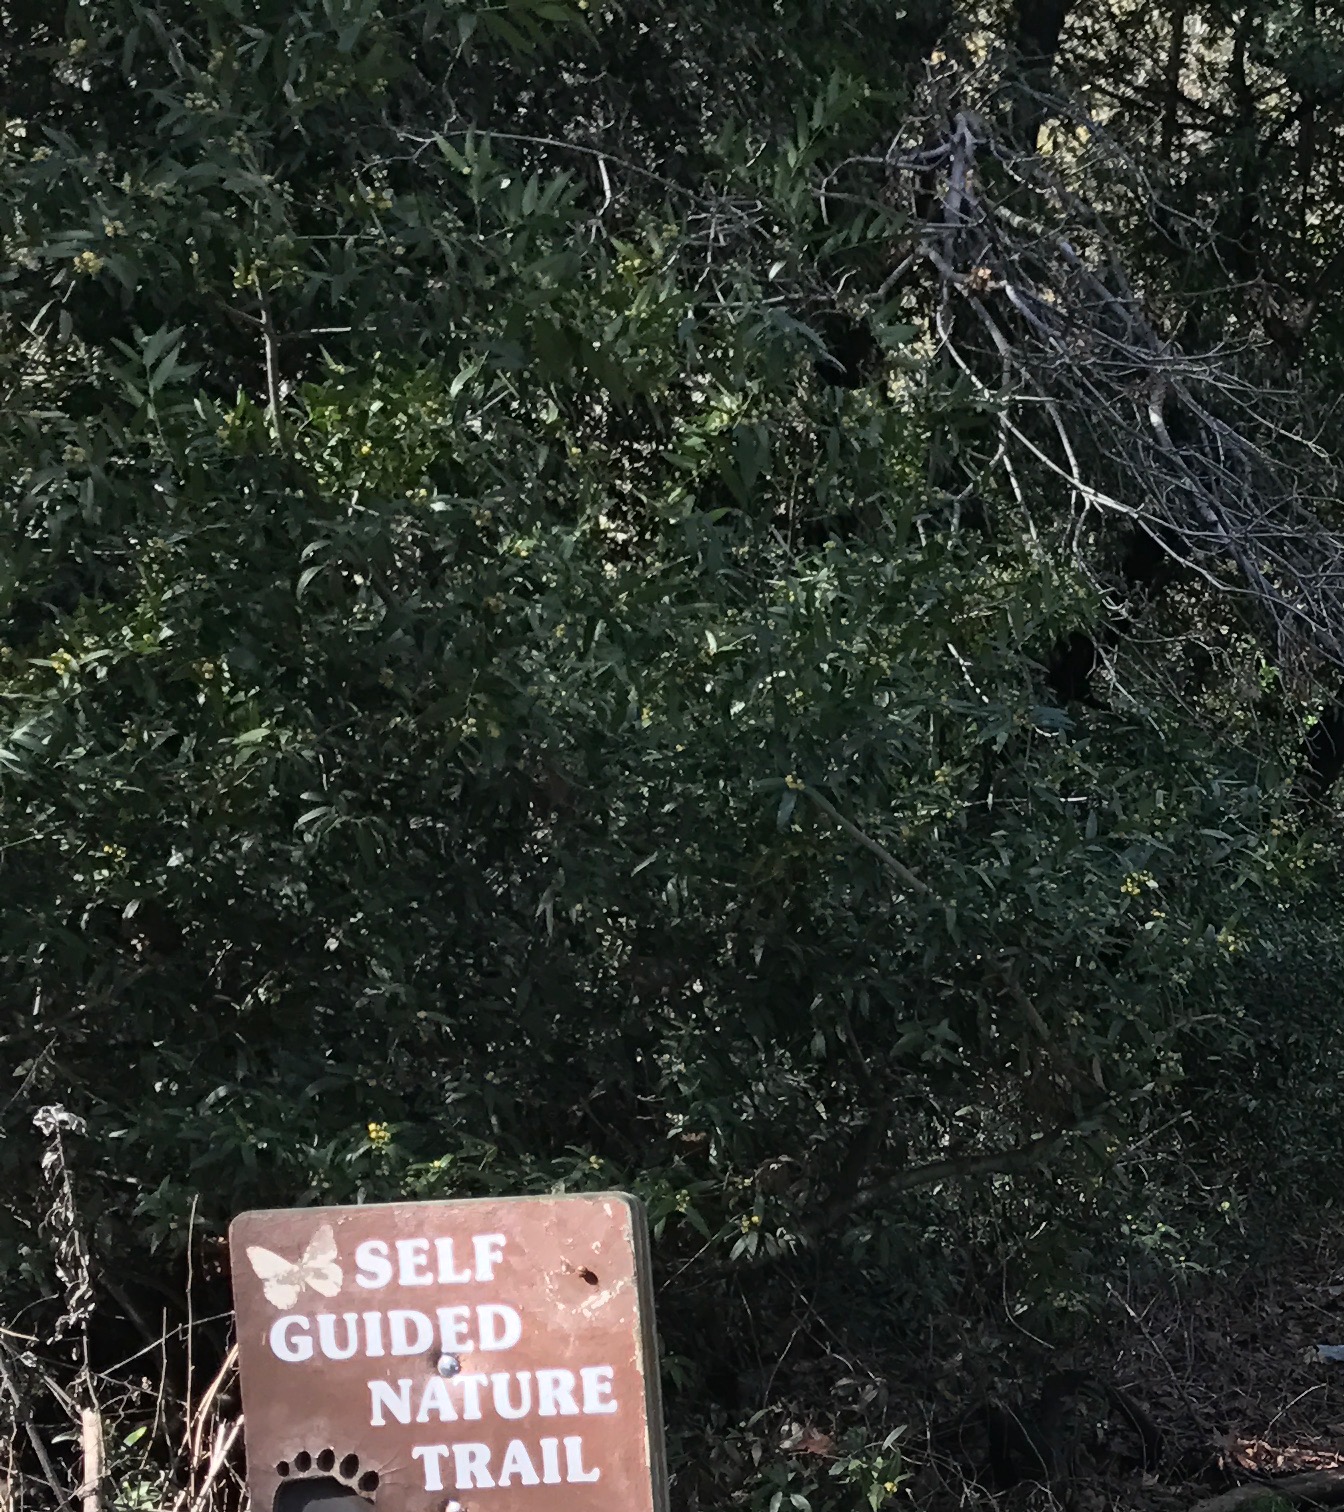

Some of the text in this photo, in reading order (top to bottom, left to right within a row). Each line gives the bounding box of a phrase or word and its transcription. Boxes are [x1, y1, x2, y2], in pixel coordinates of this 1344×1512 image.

[354, 1233, 507, 1289] SELF
[269, 1304, 522, 1362] GUIDED
[367, 1365, 618, 1427] NATURE
[411, 1436, 601, 1492] TRAIL
